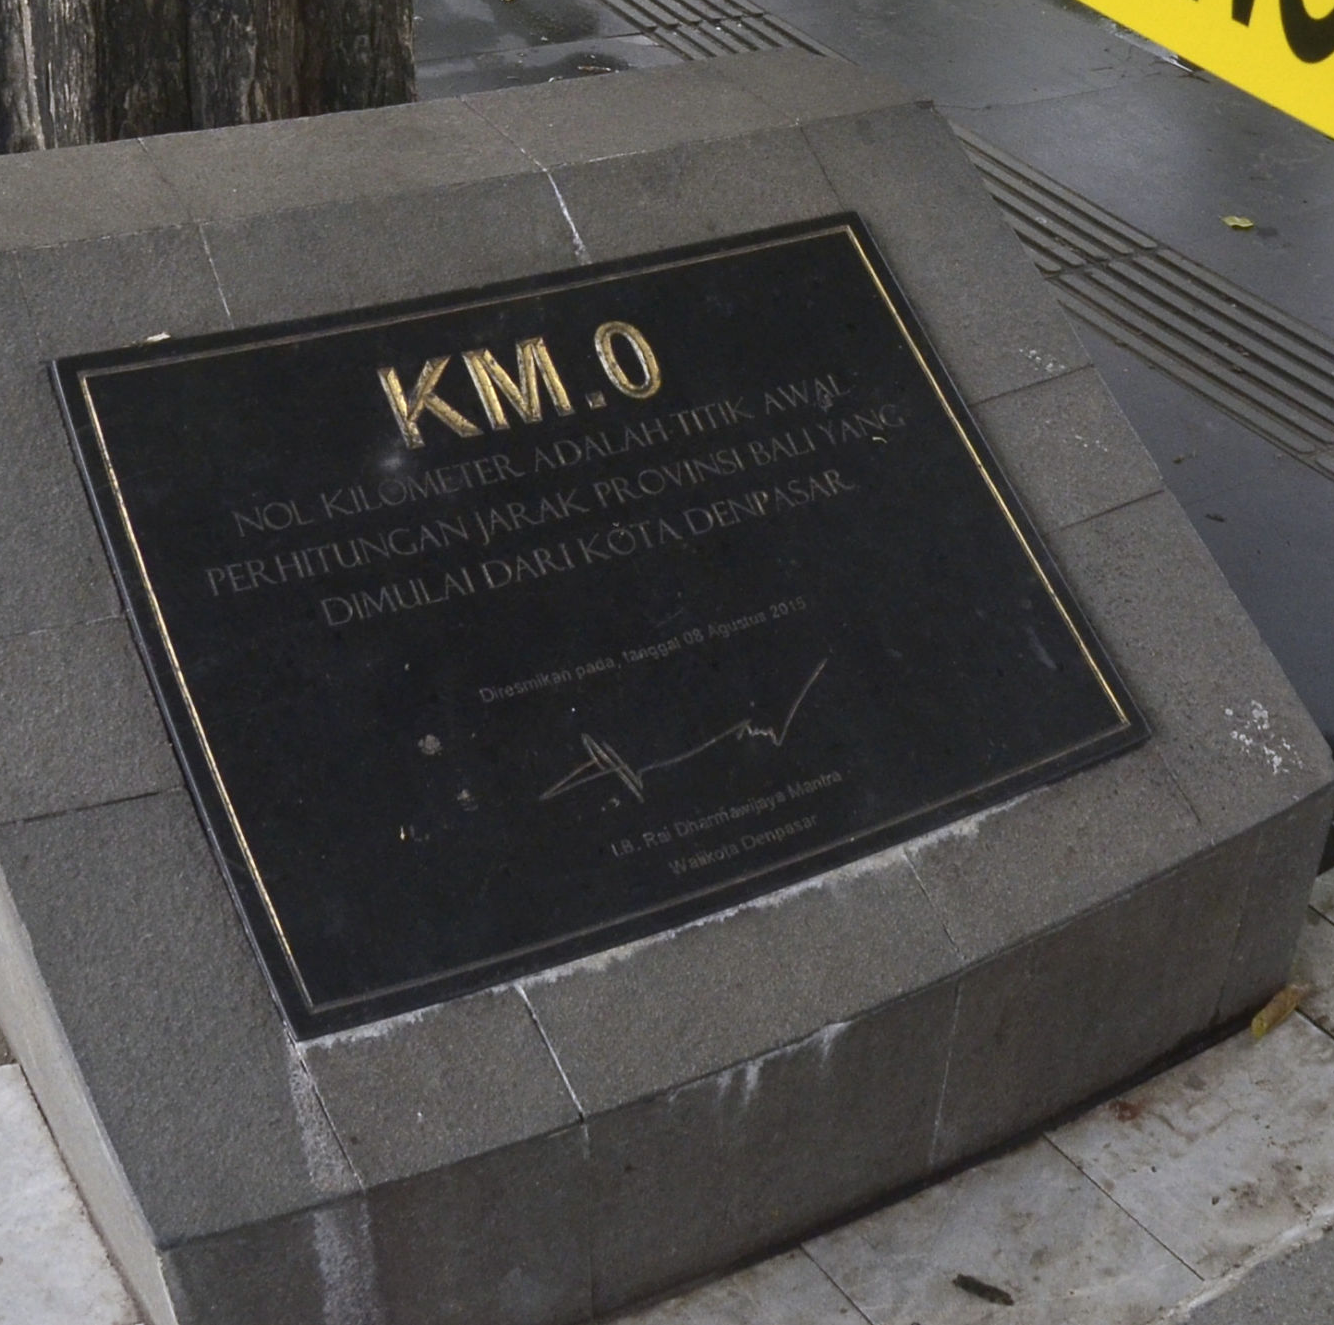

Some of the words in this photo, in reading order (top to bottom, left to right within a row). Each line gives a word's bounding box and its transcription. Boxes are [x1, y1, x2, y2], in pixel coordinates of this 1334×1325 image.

[204, 516, 469, 597] PERHITUNGAN
[474, 491, 591, 546] JARAK
[593, 448, 746, 508] PROVINSI
[748, 428, 816, 465] BALI
[817, 403, 906, 447] YANG
[231, 500, 314, 538] NOL
[319, 453, 525, 519] KILOMETER
[533, 418, 668, 472] ADALAH
[669, 396, 756, 436] TITIK
[763, 375, 851, 416] AWAL
[320, 567, 475, 627] DIMULAI
[479, 542, 576, 590] DARI
[579, 519, 684, 565] KOTA
[683, 468, 856, 536] DENPASAR
[478, 668, 572, 704] Diresmikan
[623, 636, 682, 665] tanggal
[682, 627, 705, 646] 08
[642, 827, 671, 848] Rai
[786, 770, 843, 800] Mantra
[741, 814, 817, 851] Denpasar
